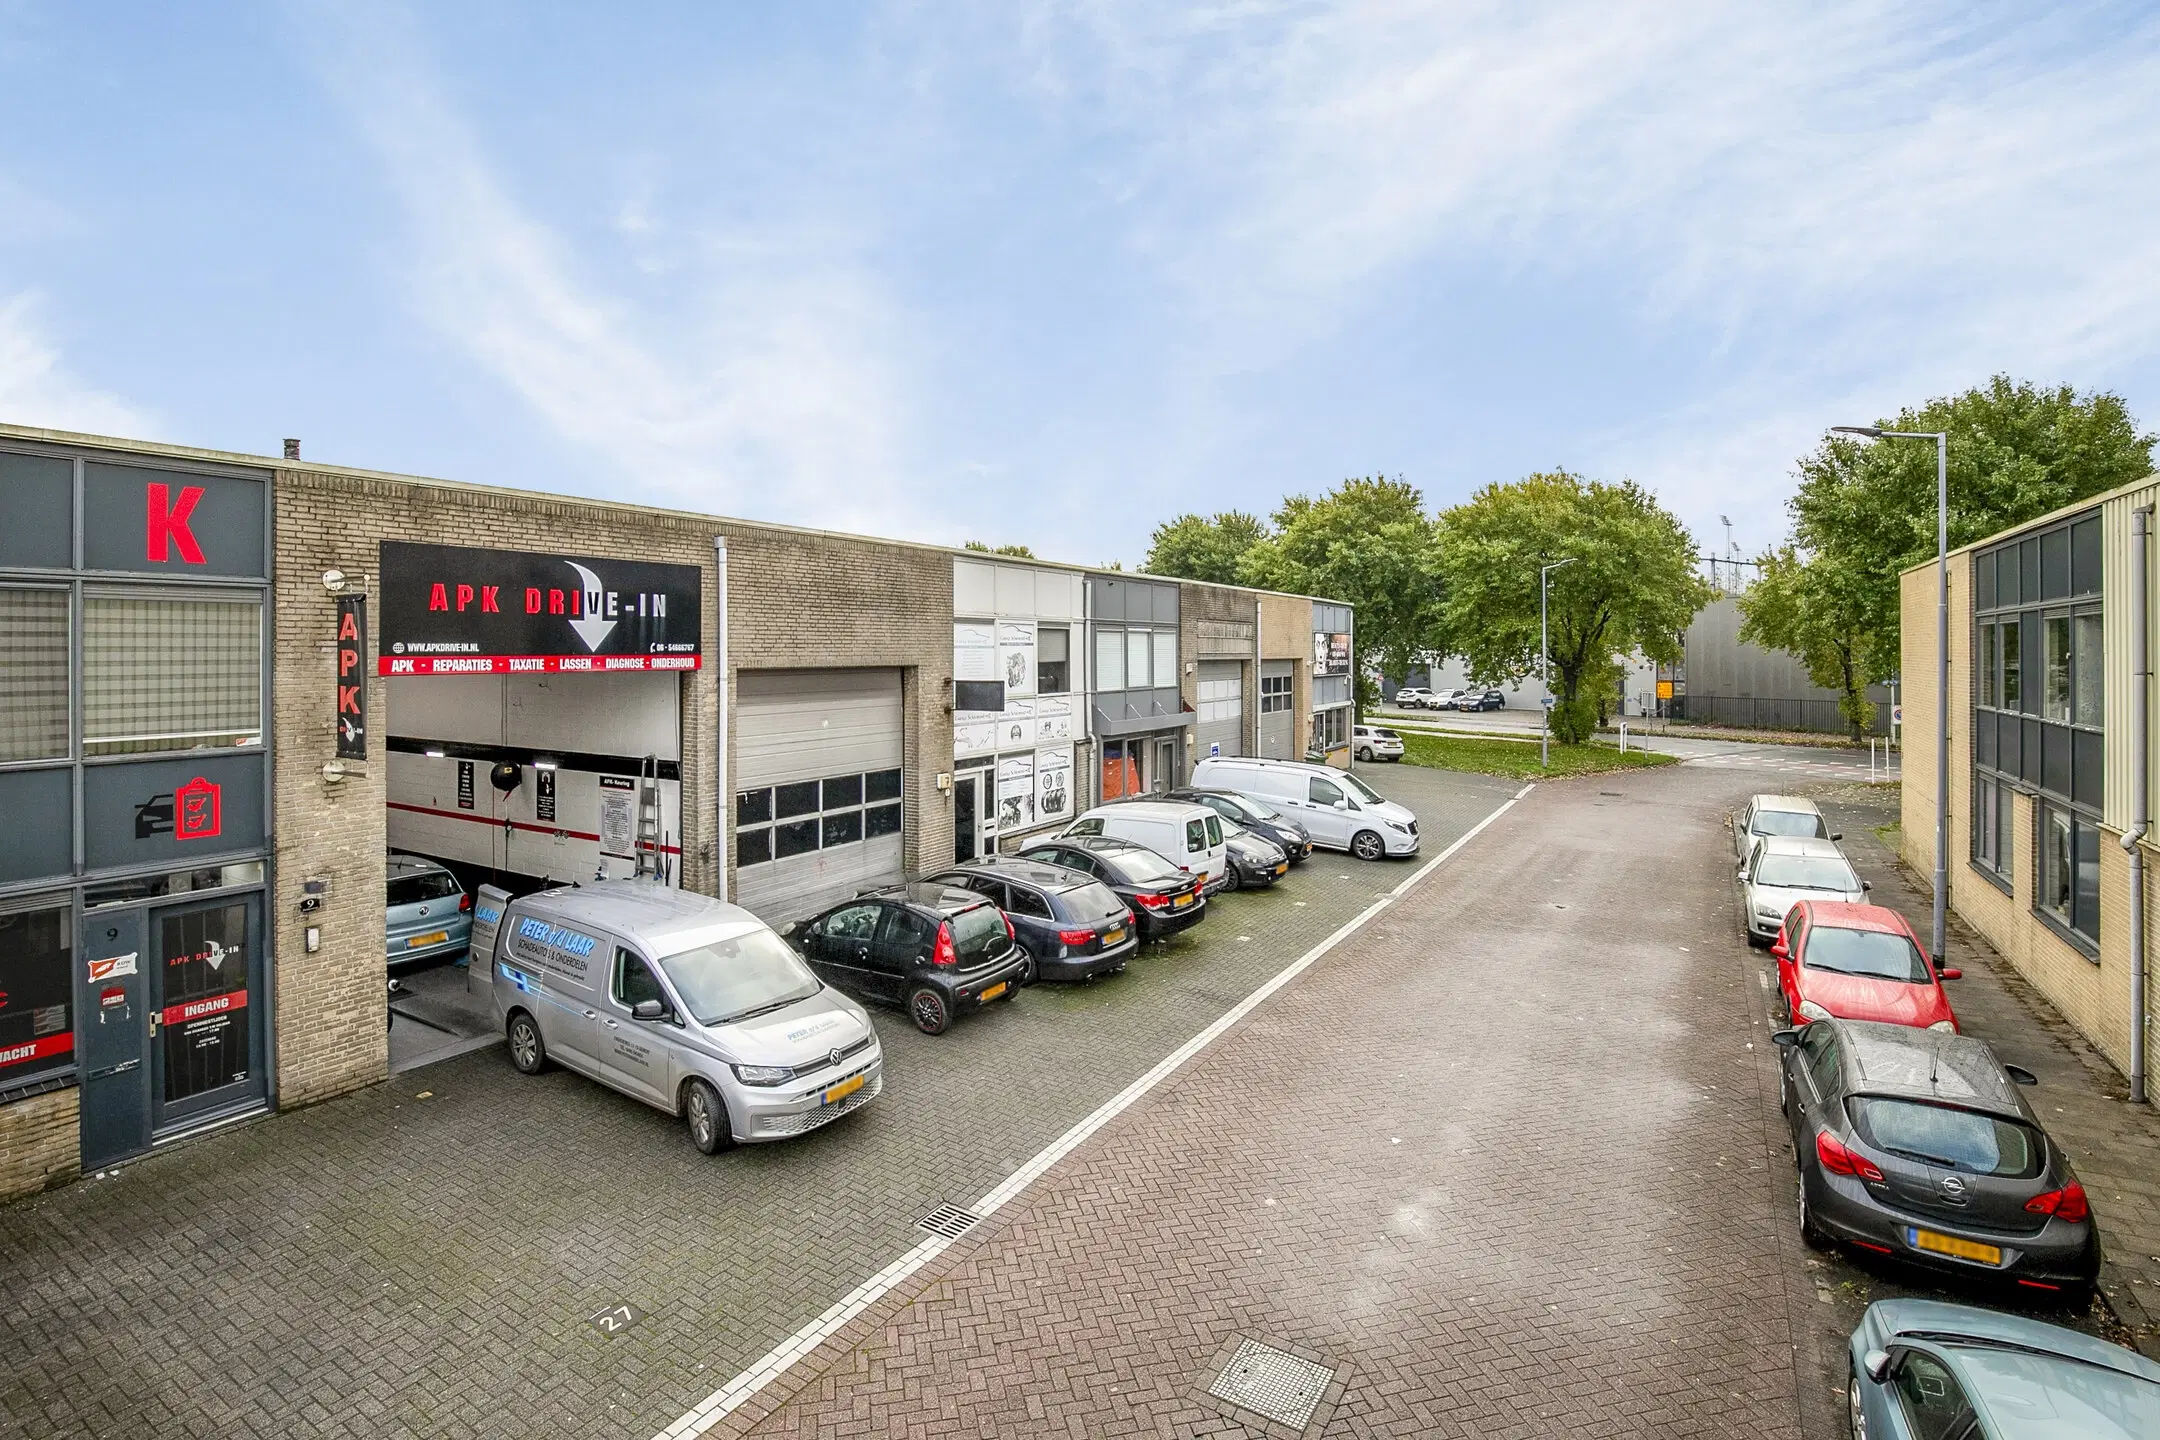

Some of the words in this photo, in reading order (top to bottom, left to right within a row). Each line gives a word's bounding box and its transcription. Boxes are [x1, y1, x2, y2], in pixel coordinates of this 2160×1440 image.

[147, 482, 208, 564] K
[429, 583, 500, 614] APK
[525, 587, 666, 617] DRIVE-IN
[407, 642, 480, 653] WWW.APKDRIVE-IN.NL
[338, 612, 361, 714] APK
[391, 660, 414, 672] APK
[433, 659, 493, 672] REPARATIES
[509, 658, 545, 670] TAXATIE
[560, 658, 592, 670] LASSEN
[606, 658, 644, 669] DIAGNOSE
[651, 658, 695, 668] ONDERHOUD
[307, 899, 315, 908] 9
[106, 928, 118, 941] 9
[520, 917, 550, 942] PETER
[565, 932, 595, 957] LAAR
[169, 955, 190, 966] APK
[195, 945, 239, 961] DRIVE-IN
[555, 953, 588, 972] ONDERDELEN
[184, 997, 229, 1017] INGANG
[599, 1305, 632, 1332] 27
